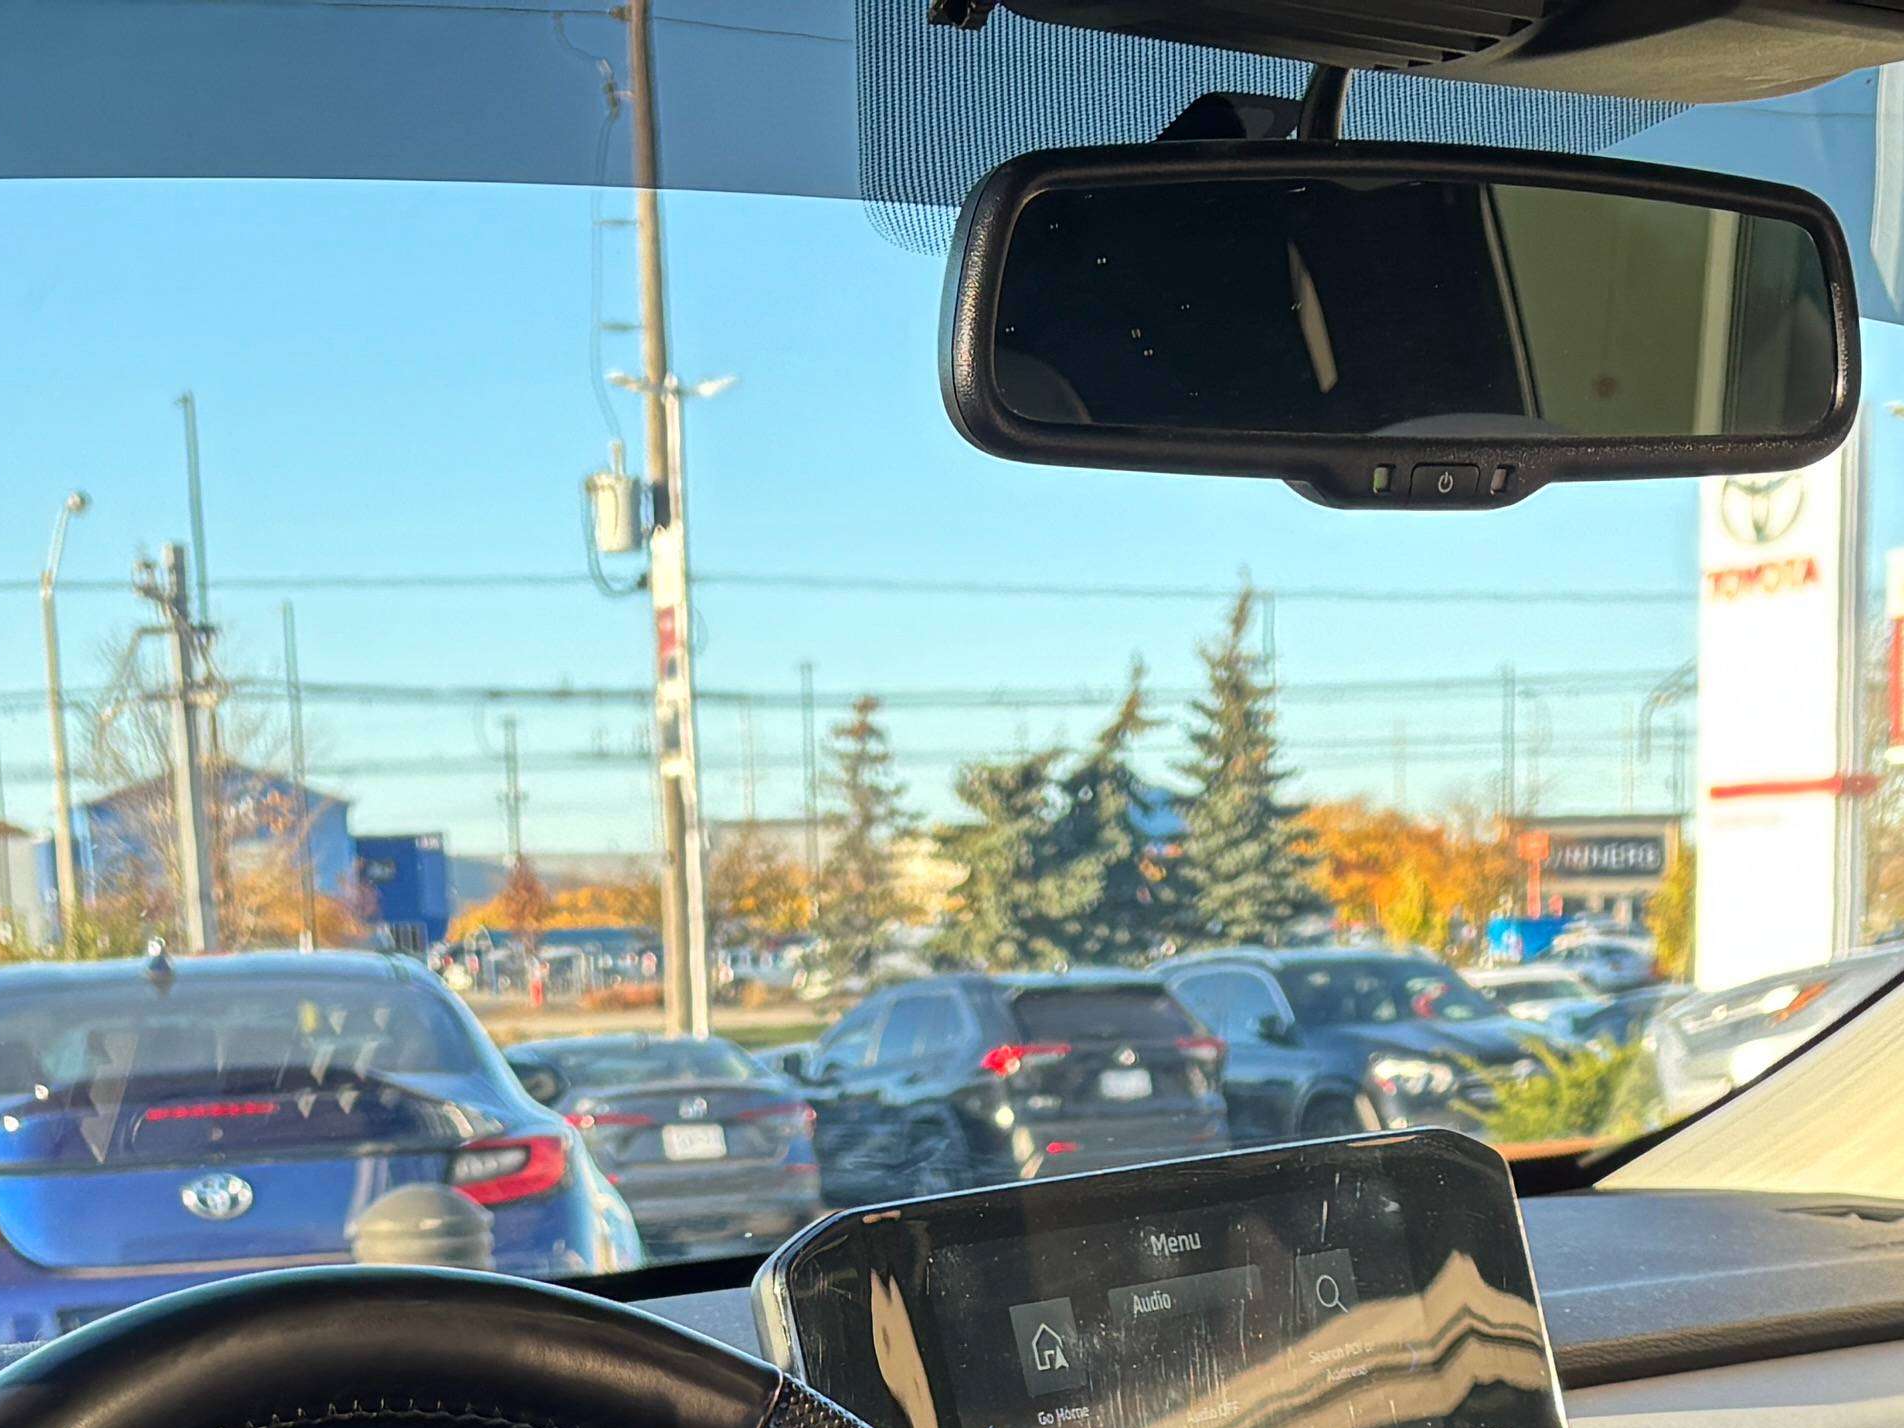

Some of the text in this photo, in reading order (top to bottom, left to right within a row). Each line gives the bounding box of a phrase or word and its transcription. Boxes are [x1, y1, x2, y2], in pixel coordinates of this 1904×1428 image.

[1150, 1231, 1202, 1257] Menu
[1133, 1291, 1172, 1315] Audio
[1037, 1404, 1090, 1426] Go Home
